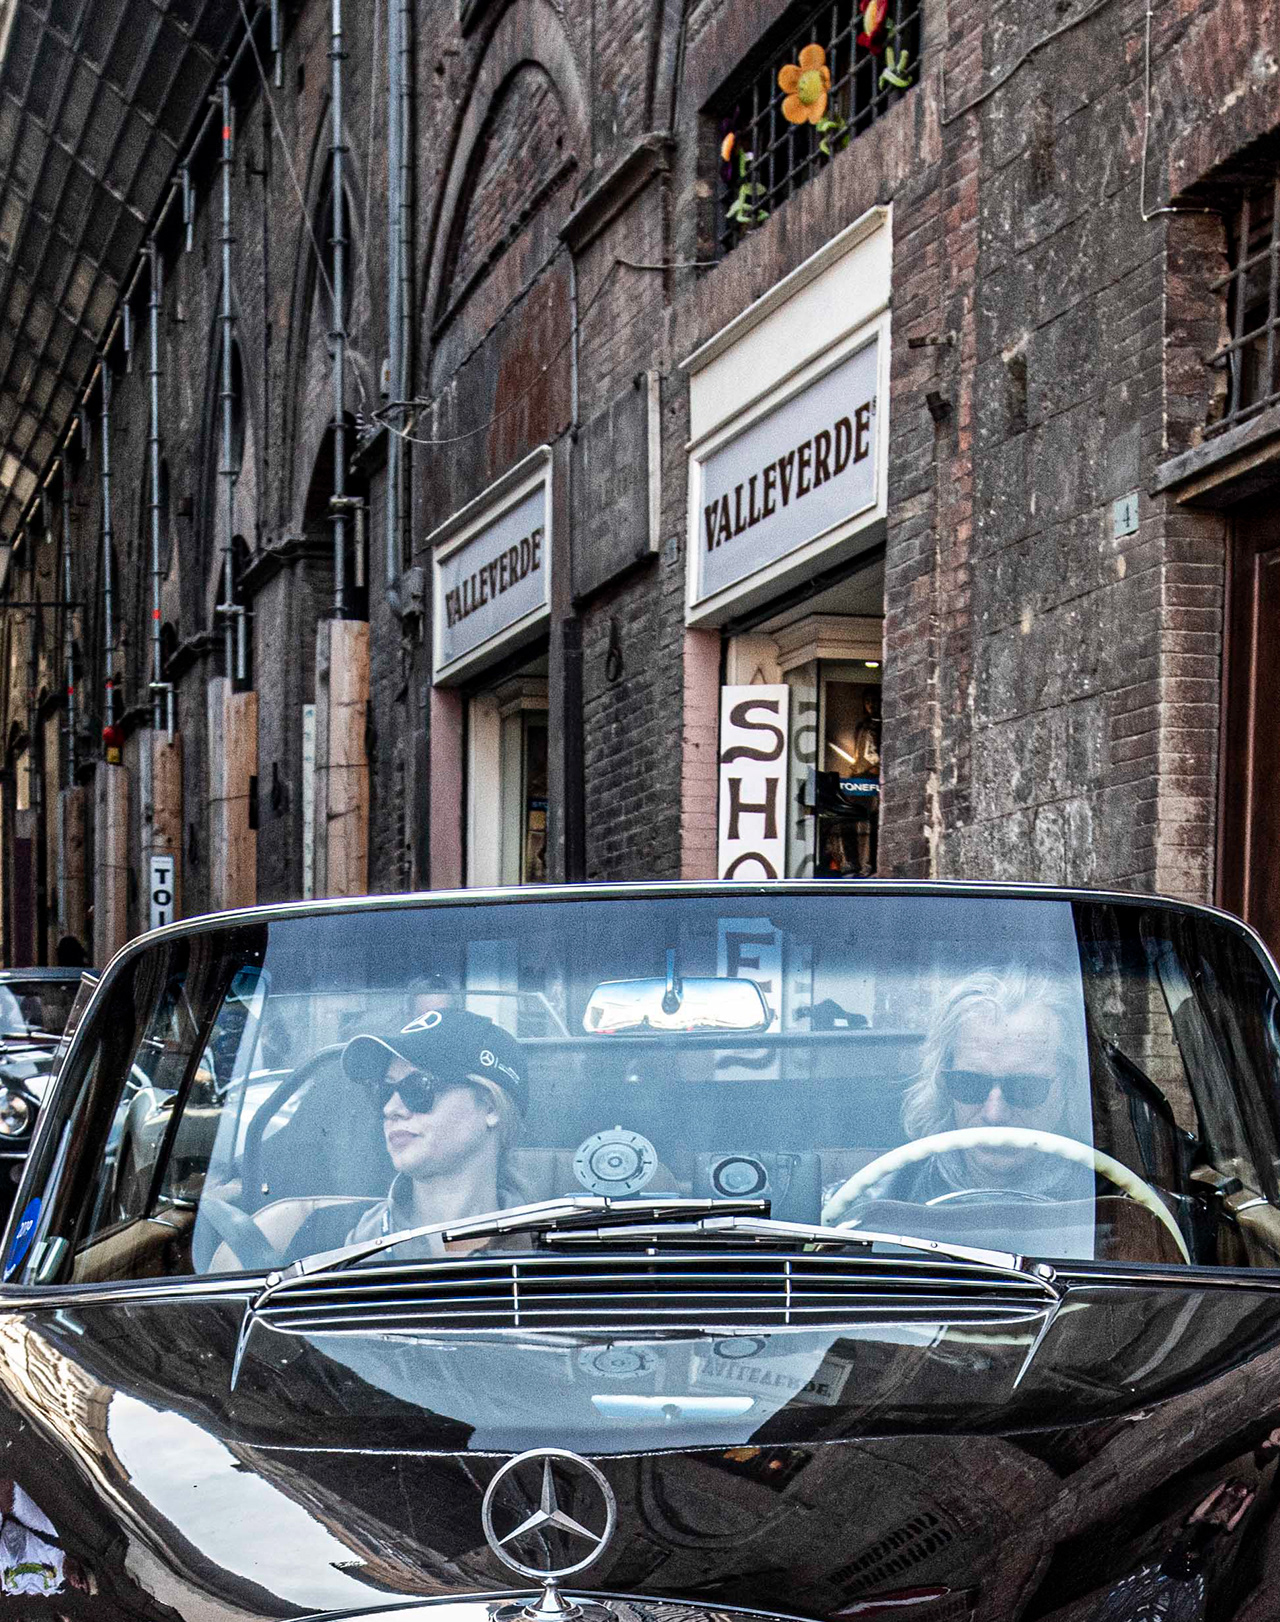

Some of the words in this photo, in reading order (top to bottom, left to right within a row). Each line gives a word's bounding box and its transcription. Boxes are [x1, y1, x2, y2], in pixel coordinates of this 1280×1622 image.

[704, 401, 870, 552] VALLEVERDE
[1122, 502, 1131, 528] 4
[444, 528, 542, 629] VALLEVERDE
